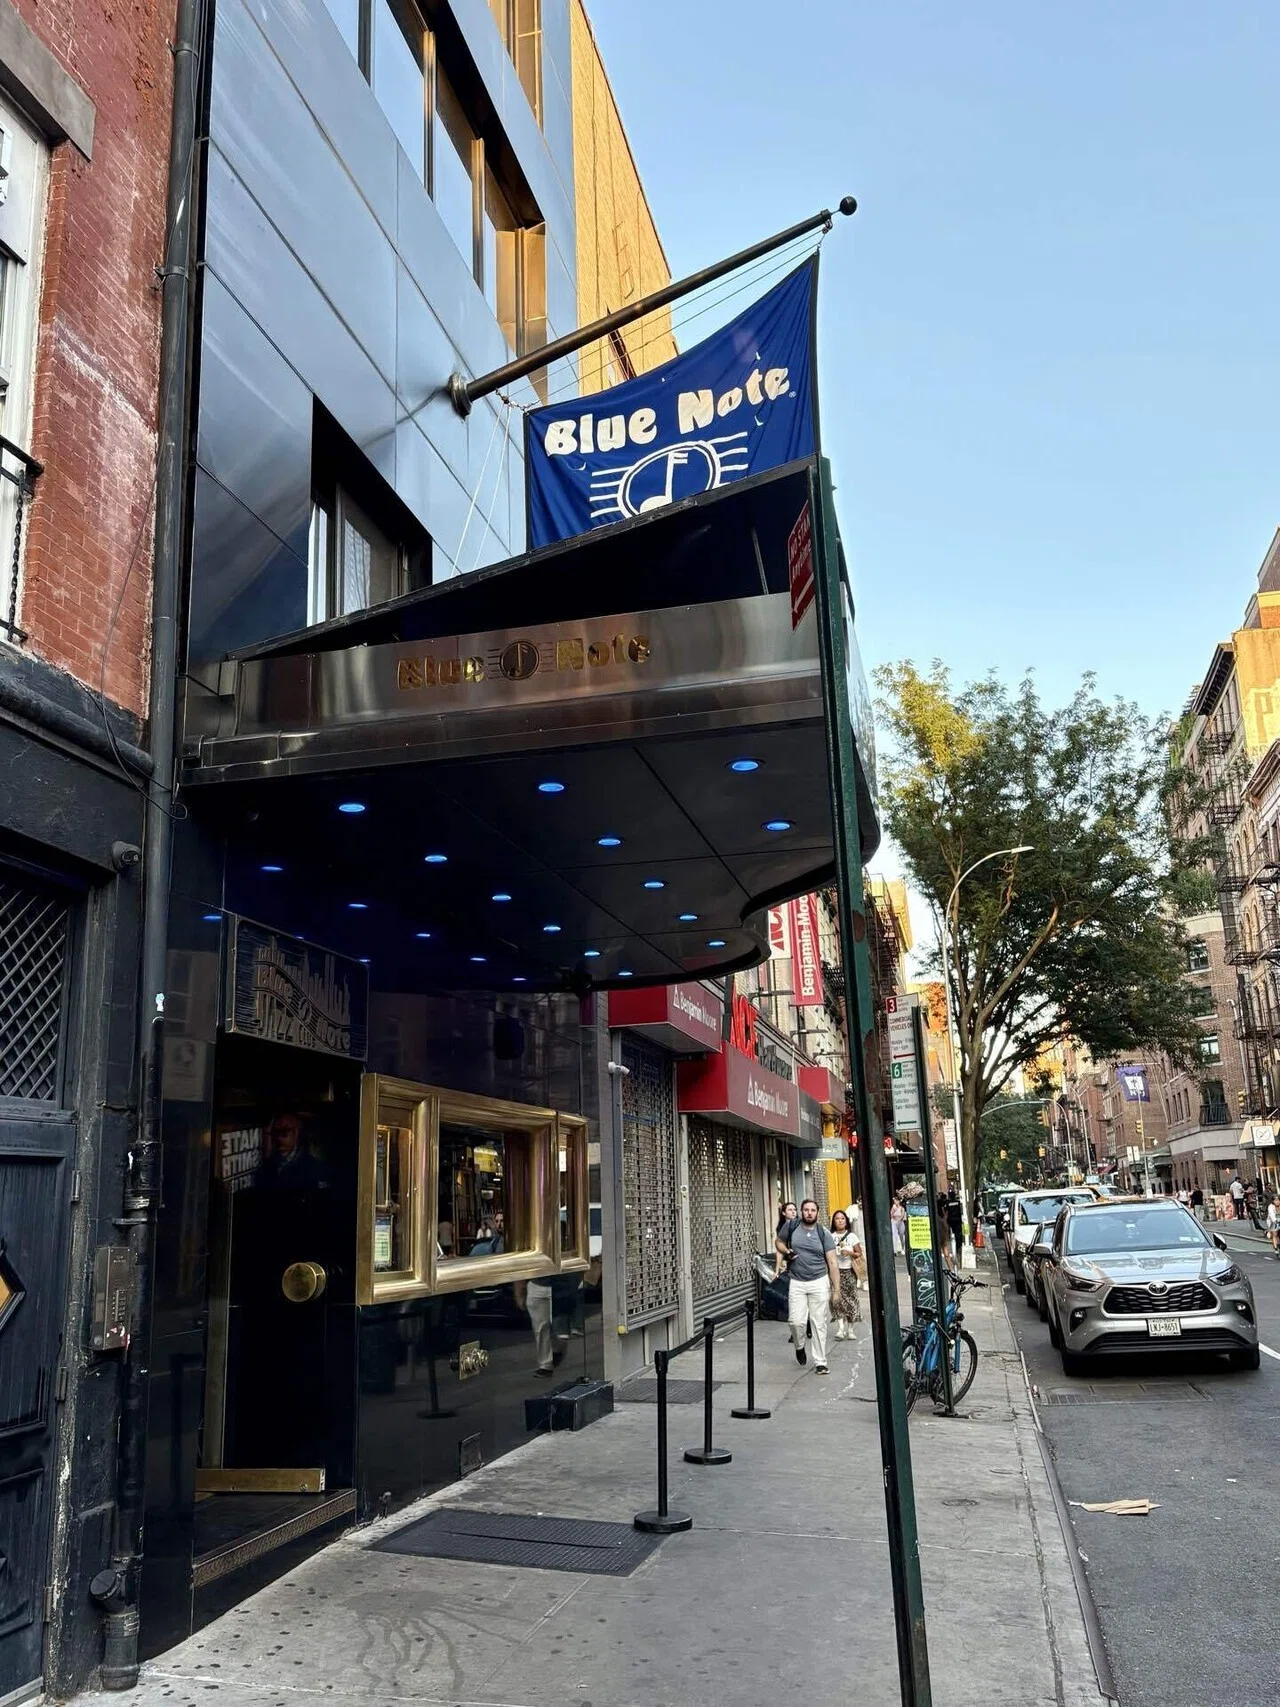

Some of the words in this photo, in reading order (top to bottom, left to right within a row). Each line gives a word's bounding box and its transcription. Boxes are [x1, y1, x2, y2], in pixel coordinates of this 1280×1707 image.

[545, 408, 657, 456] Blue
[677, 367, 790, 434] Note
[397, 655, 485, 690] Blue
[556, 632, 651, 673] Note
[797, 895, 810, 925] Moo
[799, 925, 816, 996] Benjamin
[680, 991, 702, 1023] Benjamin
[702, 1005, 717, 1031] Moore
[889, 999, 895, 1012] 3
[894, 1064, 900, 1077] 6
[754, 1081, 776, 1116] Benjamin
